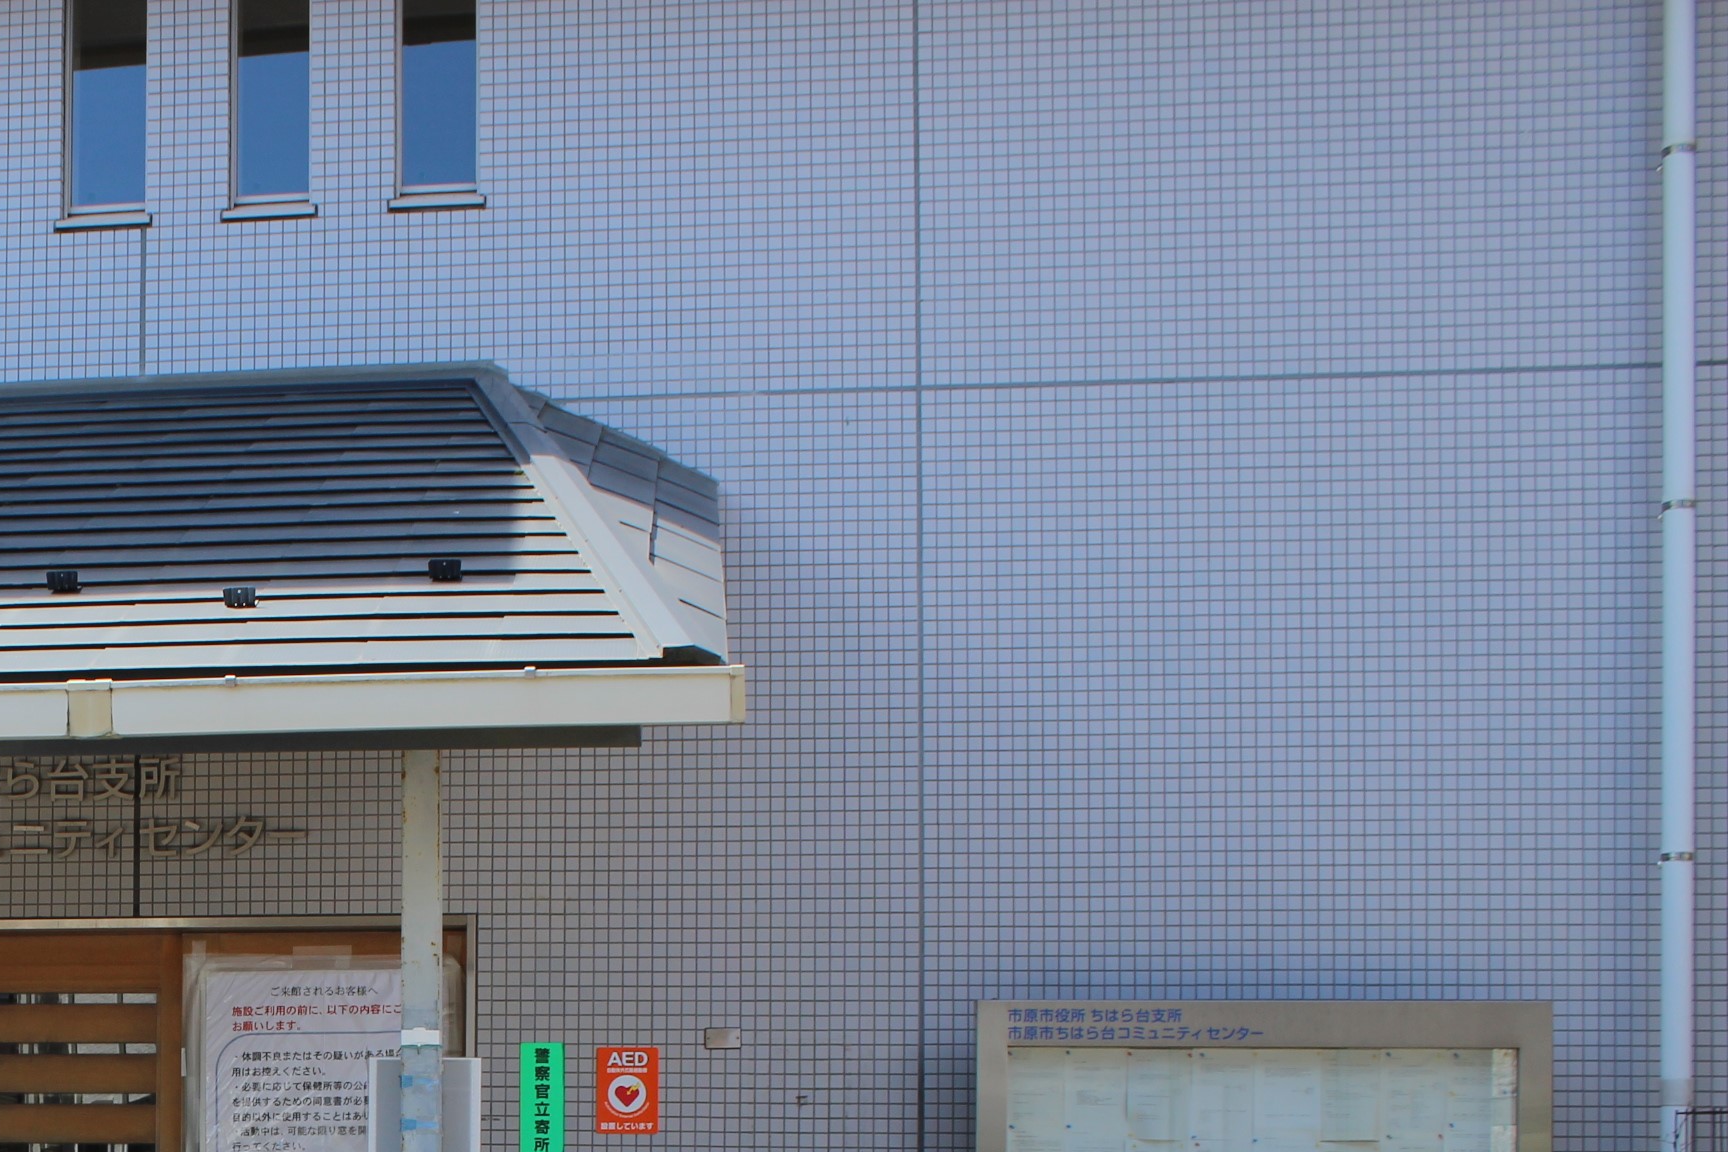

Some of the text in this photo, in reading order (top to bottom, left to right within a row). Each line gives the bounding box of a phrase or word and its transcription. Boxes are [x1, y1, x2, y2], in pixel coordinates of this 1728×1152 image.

[271, 986, 378, 997] ご来館されるお客様へ
[1007, 1008, 1182, 1023] 市原市役所 ちはら台支所
[232, 1021, 301, 1031] お願いします。
[1007, 1026, 1264, 1040] 市原市ちはら台コミュニティセンター
[607, 1051, 648, 1067] AED
[231, 1066, 326, 1077] 用はお控えください。
[534, 1047, 550, 1152] 警察官立寄所
[232, 1142, 306, 1152] 行ってください。
